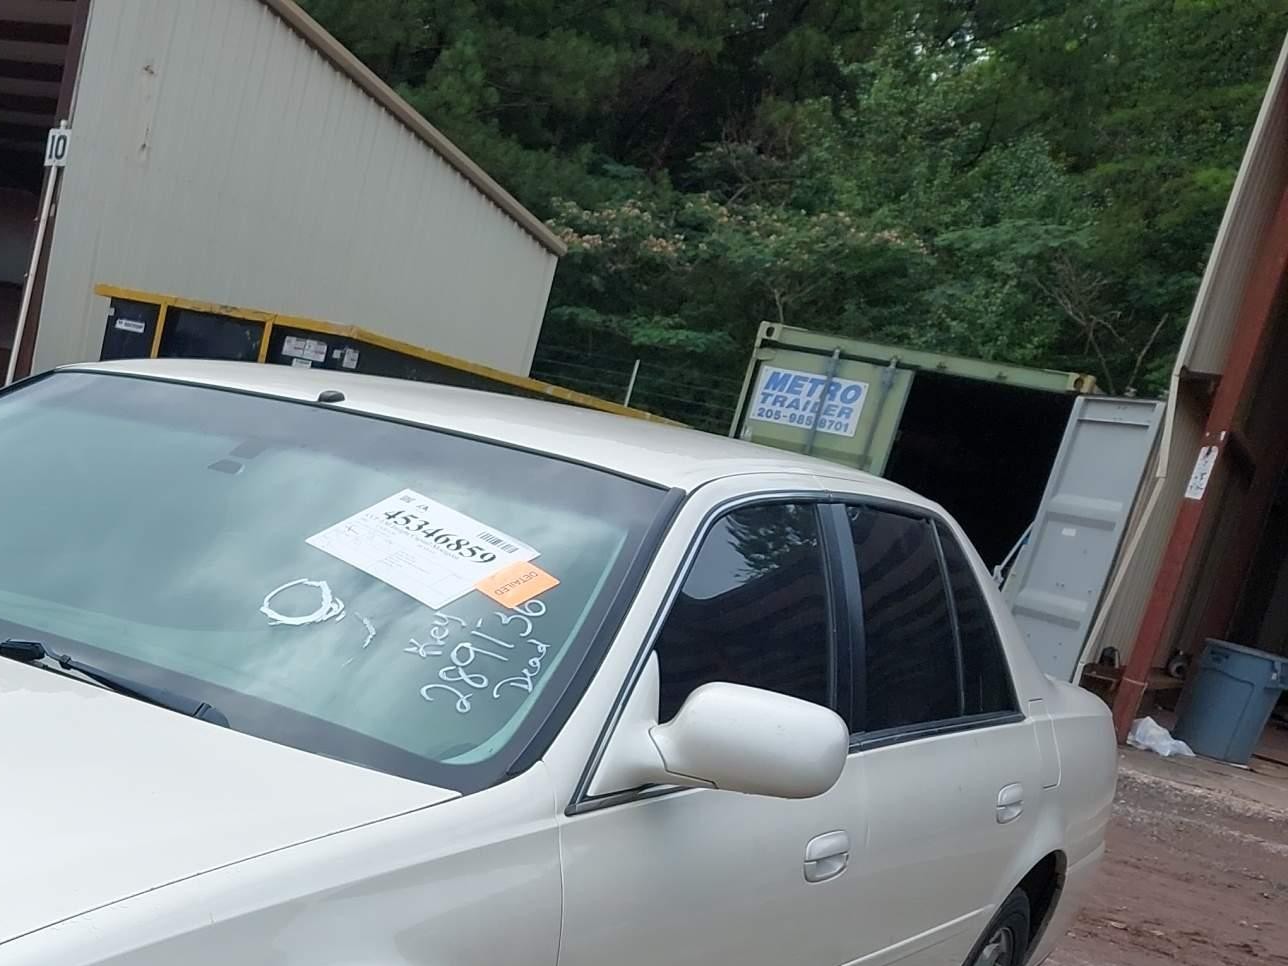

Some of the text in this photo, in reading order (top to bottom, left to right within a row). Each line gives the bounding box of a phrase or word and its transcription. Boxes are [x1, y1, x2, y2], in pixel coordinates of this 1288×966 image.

[48, 134, 67, 160] 10
[763, 371, 862, 404] METRO
[757, 407, 849, 432] 205-9858701
[383, 510, 496, 563] 45346859
[494, 571, 538, 596] DETAILED
